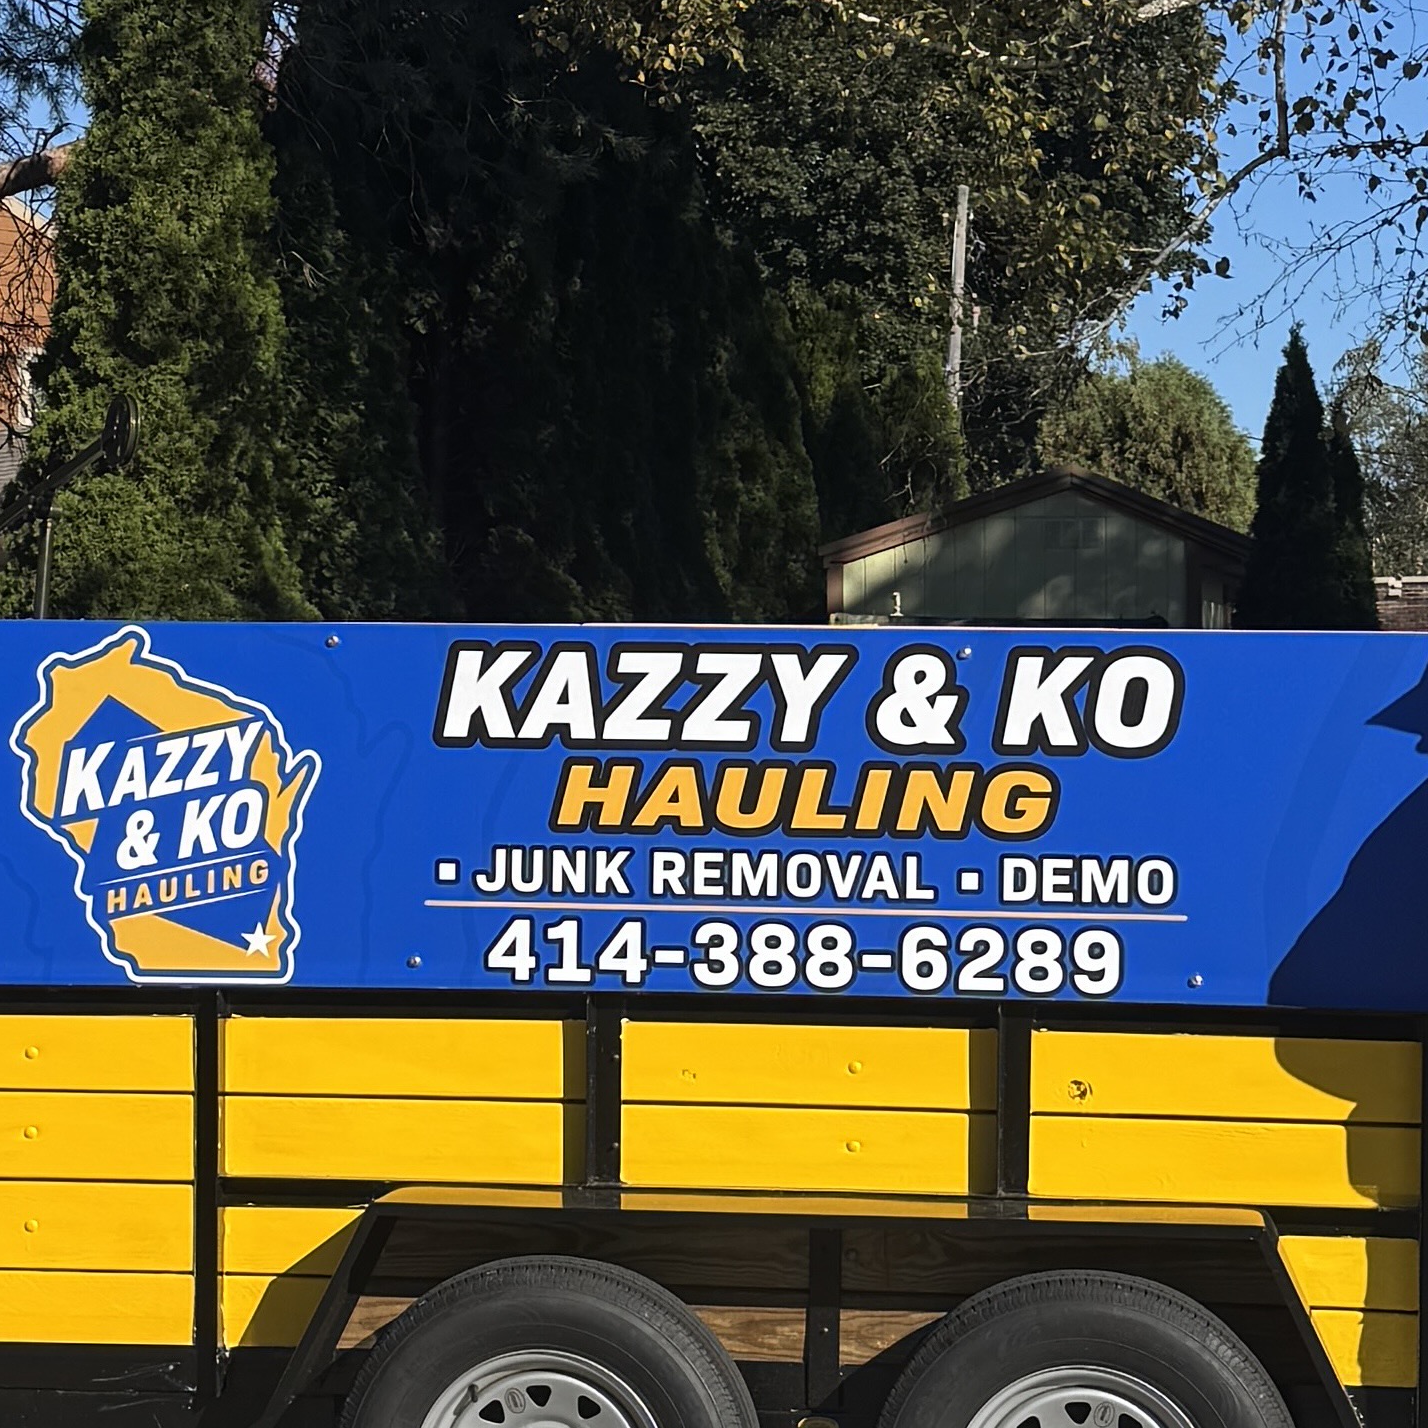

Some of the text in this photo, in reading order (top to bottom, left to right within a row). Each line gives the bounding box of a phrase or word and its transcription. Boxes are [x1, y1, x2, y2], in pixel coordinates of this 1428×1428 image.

[443, 650, 1175, 748] KAZZY & KO
[60, 721, 264, 818] KAZZY
[557, 765, 1053, 834] HAULING
[116, 788, 264, 871] & KO
[106, 860, 270, 914] HAULING
[475, 848, 1175, 905] JUNK REMOVAL DEMO
[487, 919, 1121, 995] 414-388-6289
